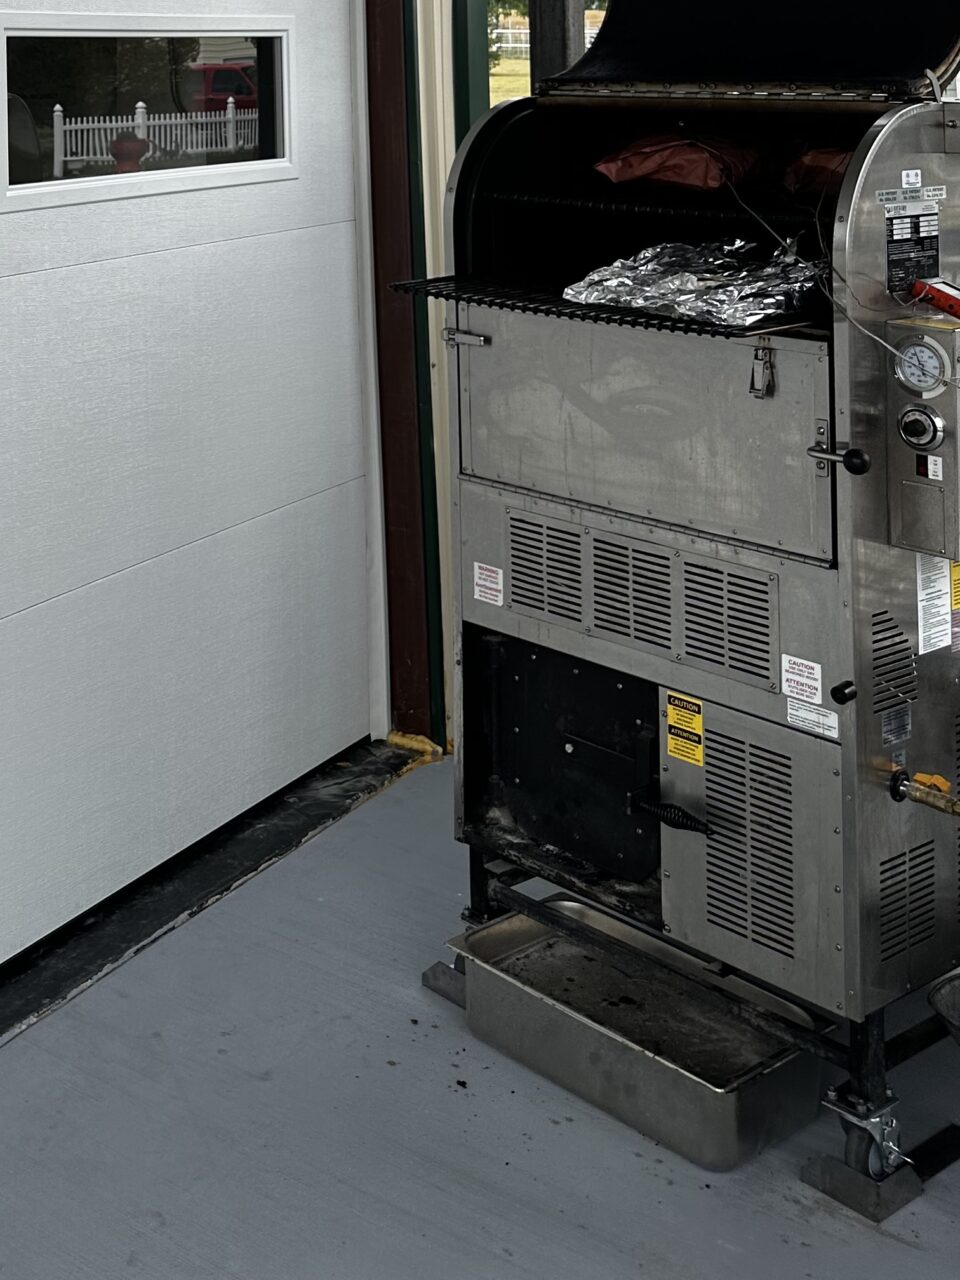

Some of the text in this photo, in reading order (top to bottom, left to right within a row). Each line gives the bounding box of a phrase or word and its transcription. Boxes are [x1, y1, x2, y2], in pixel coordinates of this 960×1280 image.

[788, 659, 815, 671] CAUTION
[785, 678, 819, 692] ATTENTION
[670, 697, 699, 712] CAUTION
[670, 728, 699, 742] ATTENTION
